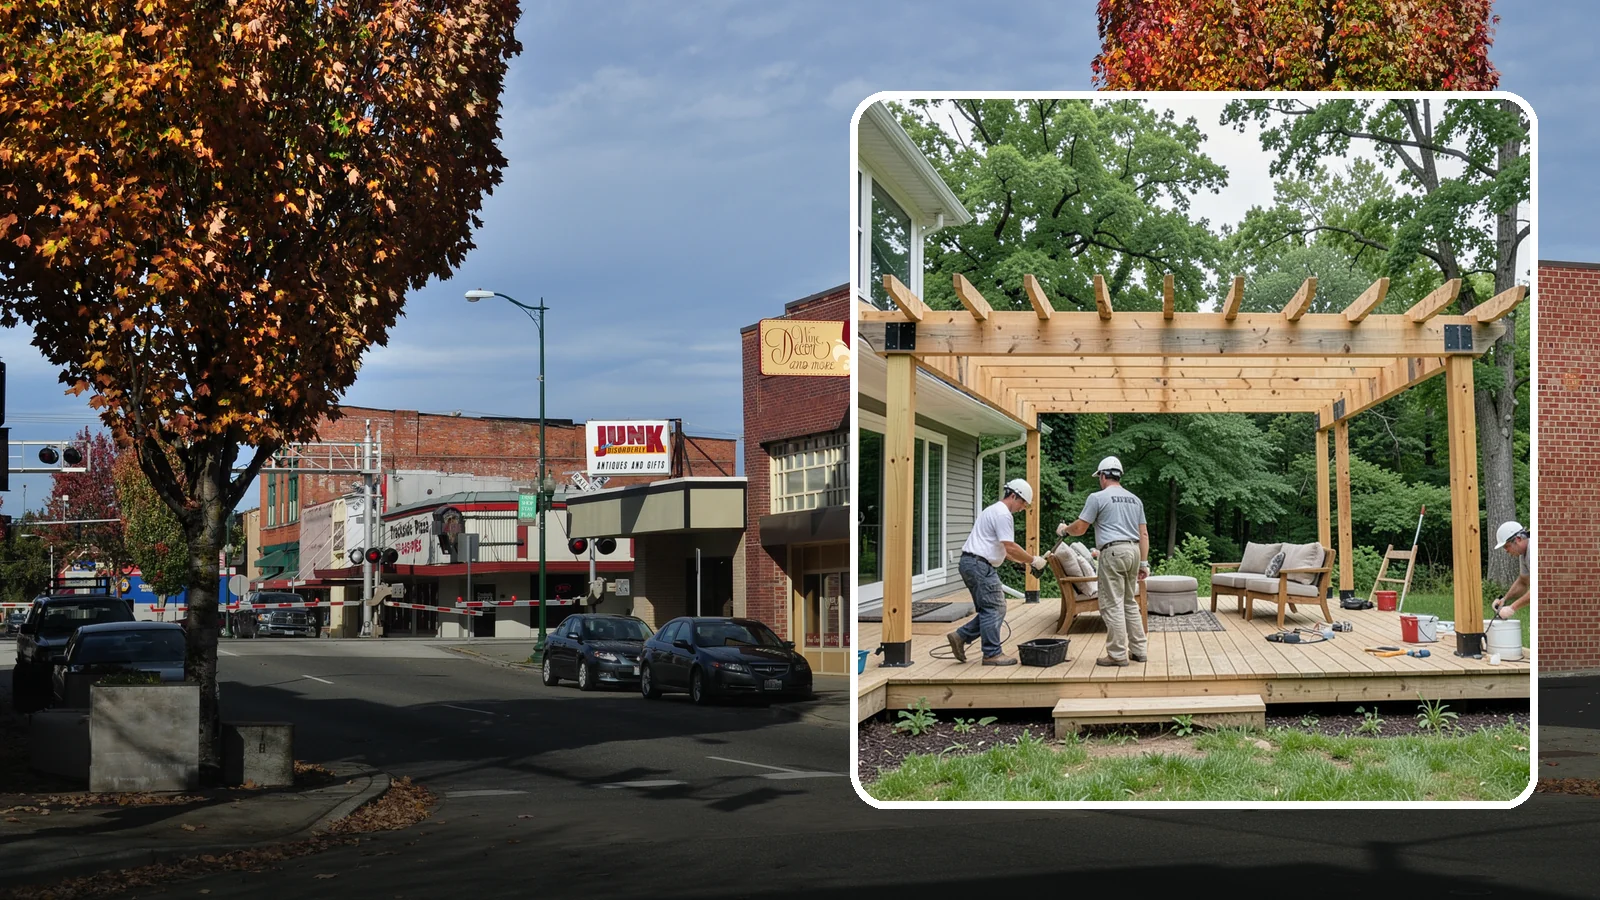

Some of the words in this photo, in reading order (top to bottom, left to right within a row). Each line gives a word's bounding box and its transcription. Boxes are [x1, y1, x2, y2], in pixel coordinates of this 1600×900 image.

[791, 325, 823, 346] Wine
[595, 425, 665, 457] JUNK
[607, 446, 646, 454] DISORDERLY
[597, 461, 628, 470] ANTIQUES
[631, 461, 643, 470] AND
[647, 460, 665, 469] GIFTS
[352, 498, 365, 510] CRO
[390, 521, 412, 539] Trackside
[415, 519, 429, 535] Pizza
